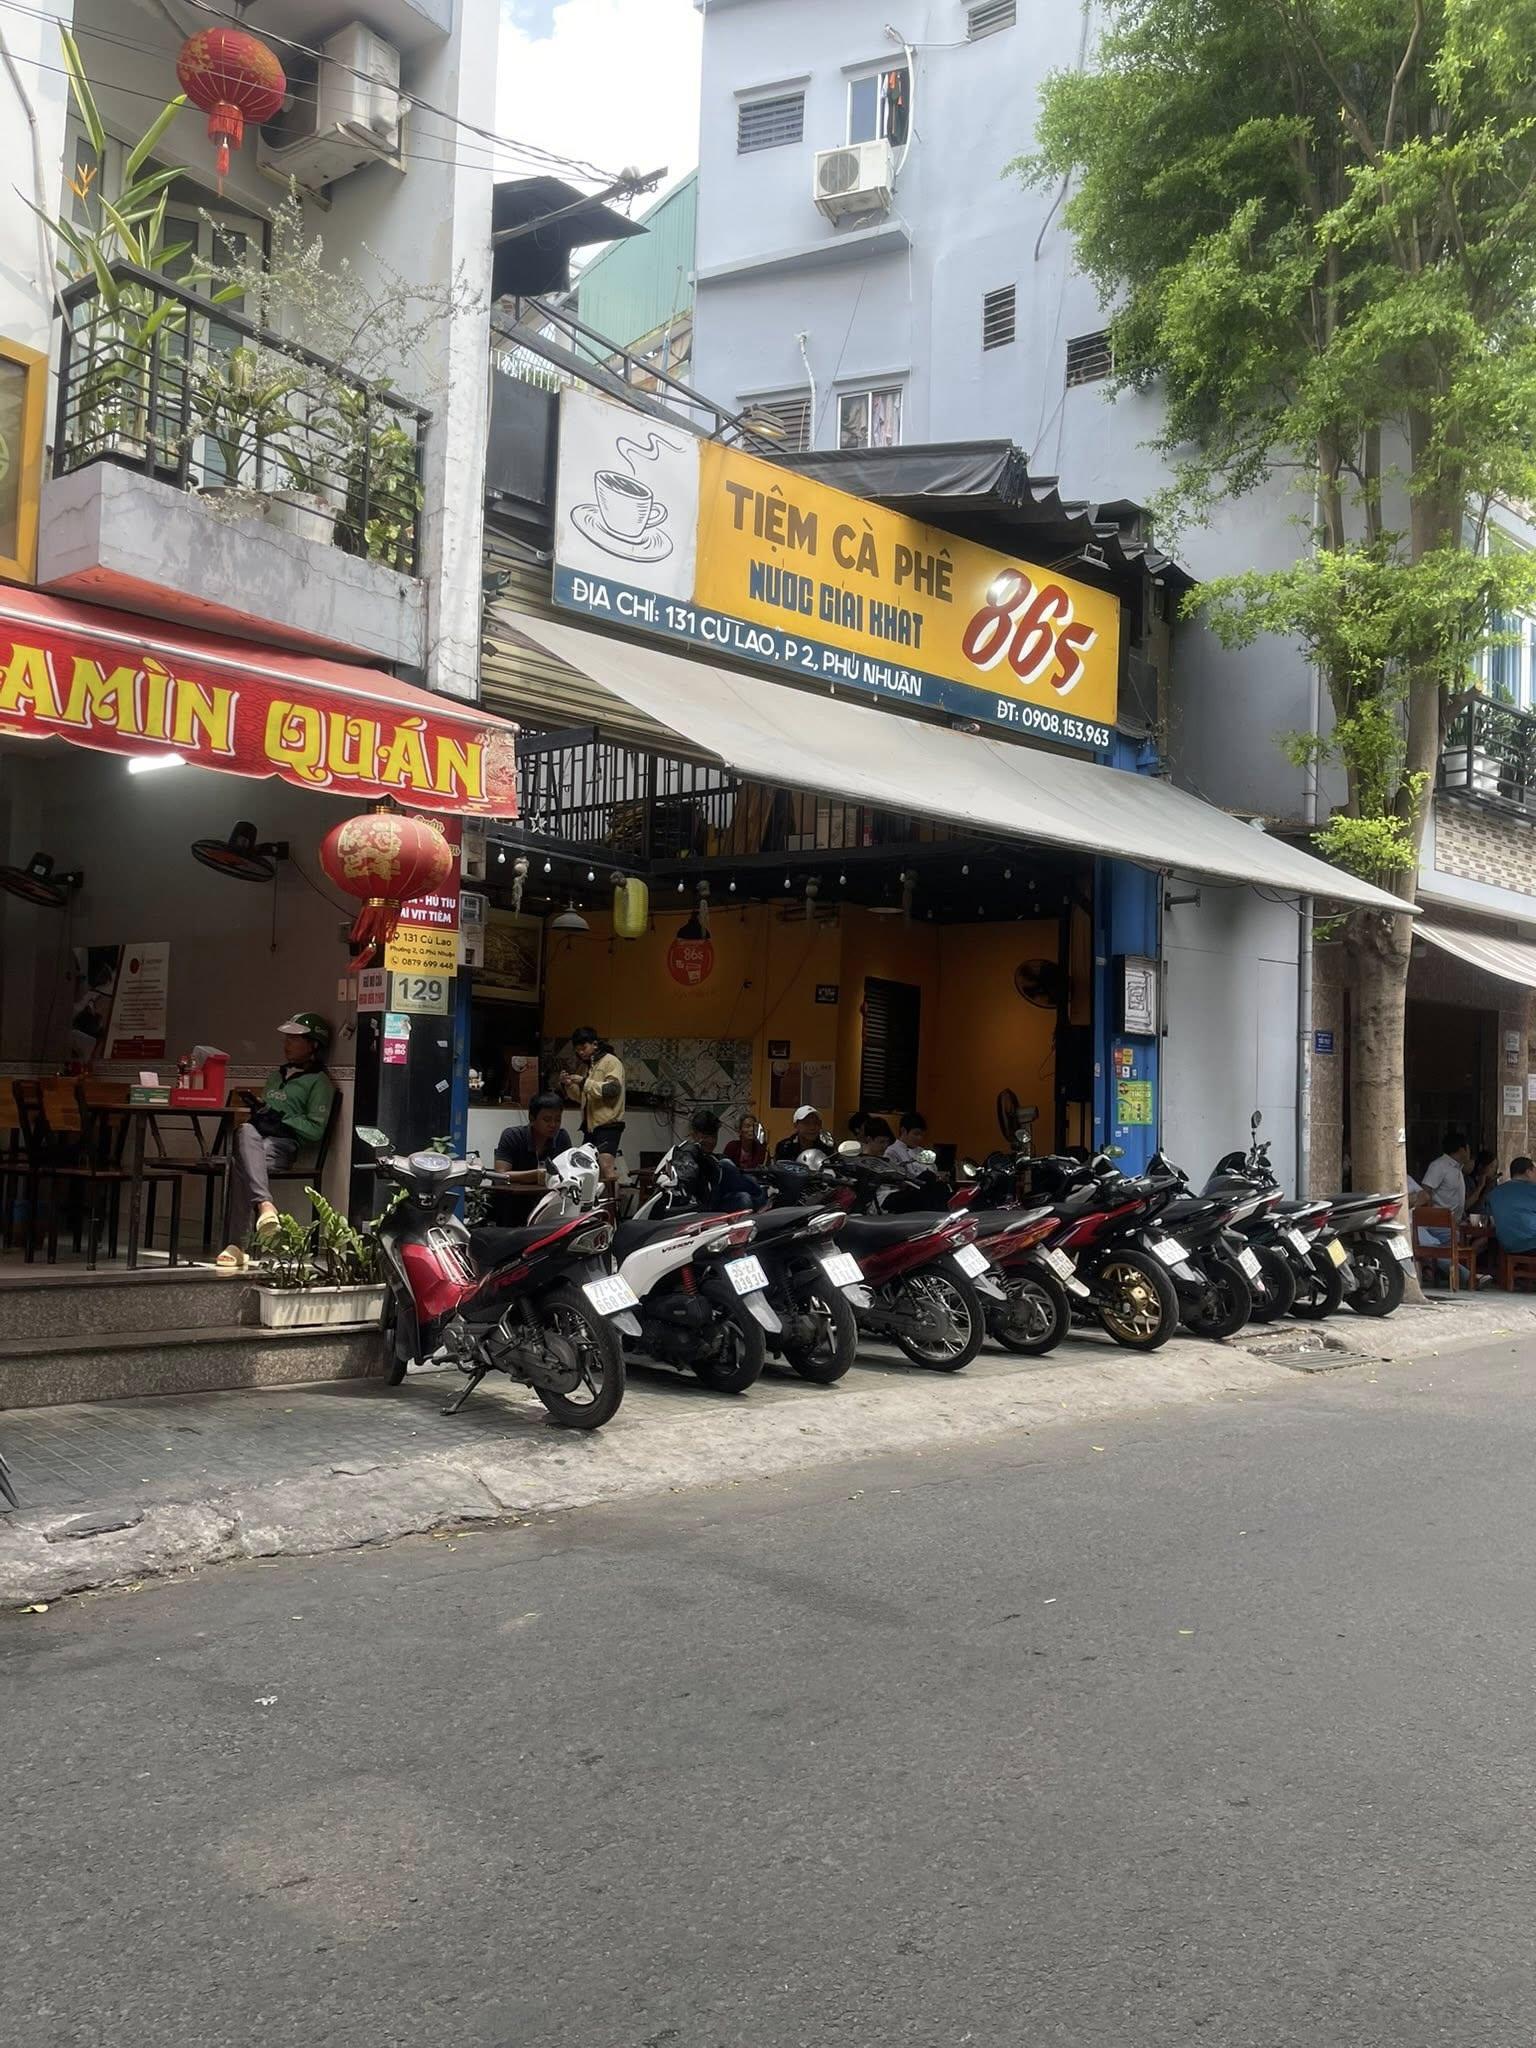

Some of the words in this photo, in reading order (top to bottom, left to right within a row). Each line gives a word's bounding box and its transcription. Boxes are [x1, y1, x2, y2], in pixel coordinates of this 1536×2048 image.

[725, 479, 818, 556] TIỆM
[832, 518, 880, 578] CÀ
[894, 543, 954, 603] PHÊ
[571, 577, 611, 611] ĐỊA
[616, 592, 659, 622] CHỈ:
[665, 605, 696, 634] 131
[734, 621, 780, 660] LAO,
[785, 640, 799, 661] P
[802, 645, 819, 670] 2,
[822, 651, 859, 679] PHÚ
[863, 662, 923, 697] NHUẬN
[961, 567, 1098, 696] 86s
[264, 700, 487, 802] QUÁN
[997, 699, 1019, 721] ĐT:
[1022, 708, 1110, 747] 0908.153.963
[399, 977, 442, 1002] 129
[403, 933, 418, 943] 131
[420, 934, 433, 944] Cù
[435, 936, 452, 946] Lao
